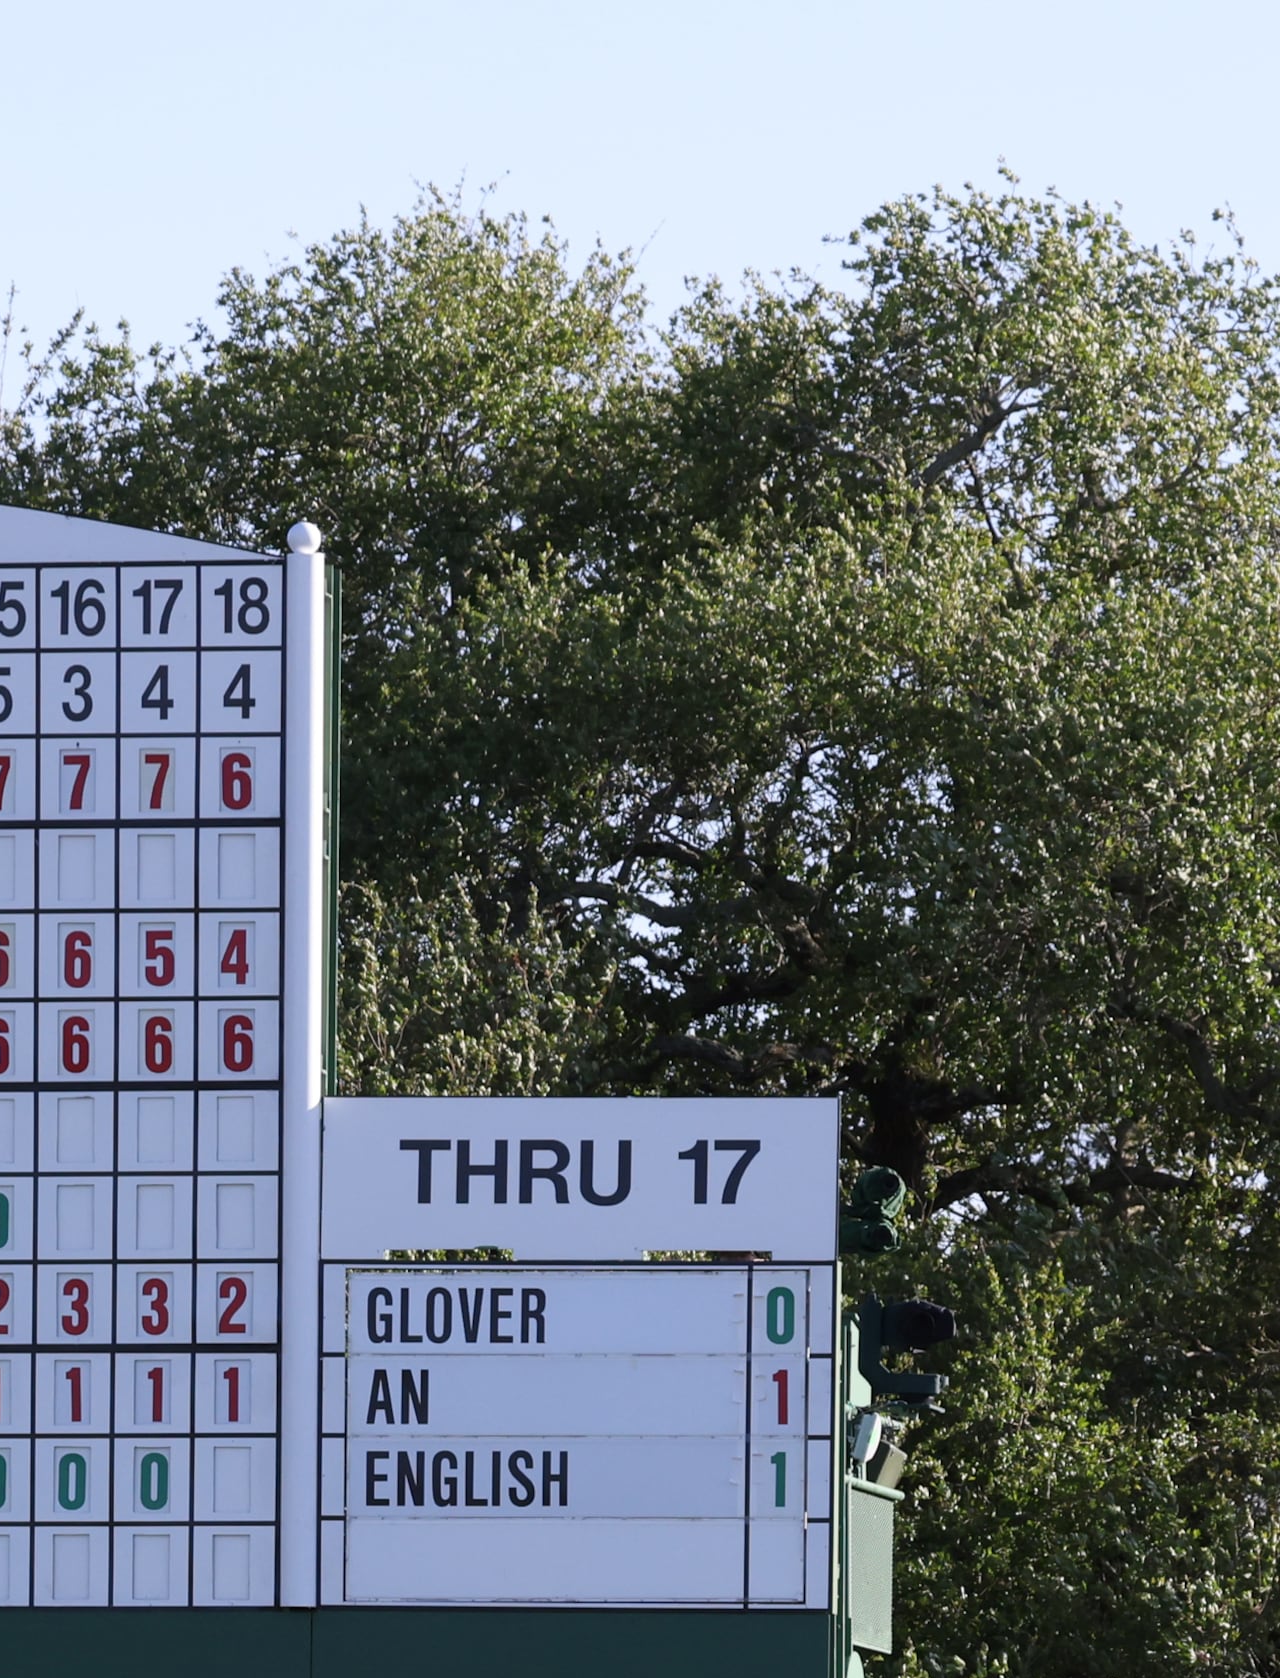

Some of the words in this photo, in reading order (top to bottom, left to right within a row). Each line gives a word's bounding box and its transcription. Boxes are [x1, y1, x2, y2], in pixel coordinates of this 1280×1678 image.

[50, 579, 106, 637] 16
[132, 579, 183, 635] 17
[214, 577, 270, 635] 18
[62, 664, 93, 722] 3
[141, 665, 174, 720] 4
[223, 664, 256, 719] 4
[64, 755, 90, 809] 7
[145, 754, 169, 809] 7
[222, 753, 251, 810] 6
[399, 1139, 632, 1207] THRU
[678, 1139, 761, 1205] 17
[62, 1279, 88, 1335] 3
[142, 1279, 168, 1335] 3
[219, 1278, 246, 1333] 2
[367, 1286, 546, 1344] GLOVER
[766, 1287, 794, 1344] 0
[366, 1369, 429, 1425] AN
[772, 1370, 788, 1425] 1
[365, 1450, 568, 1508] ENGLISH
[770, 1452, 786, 1507] 1
